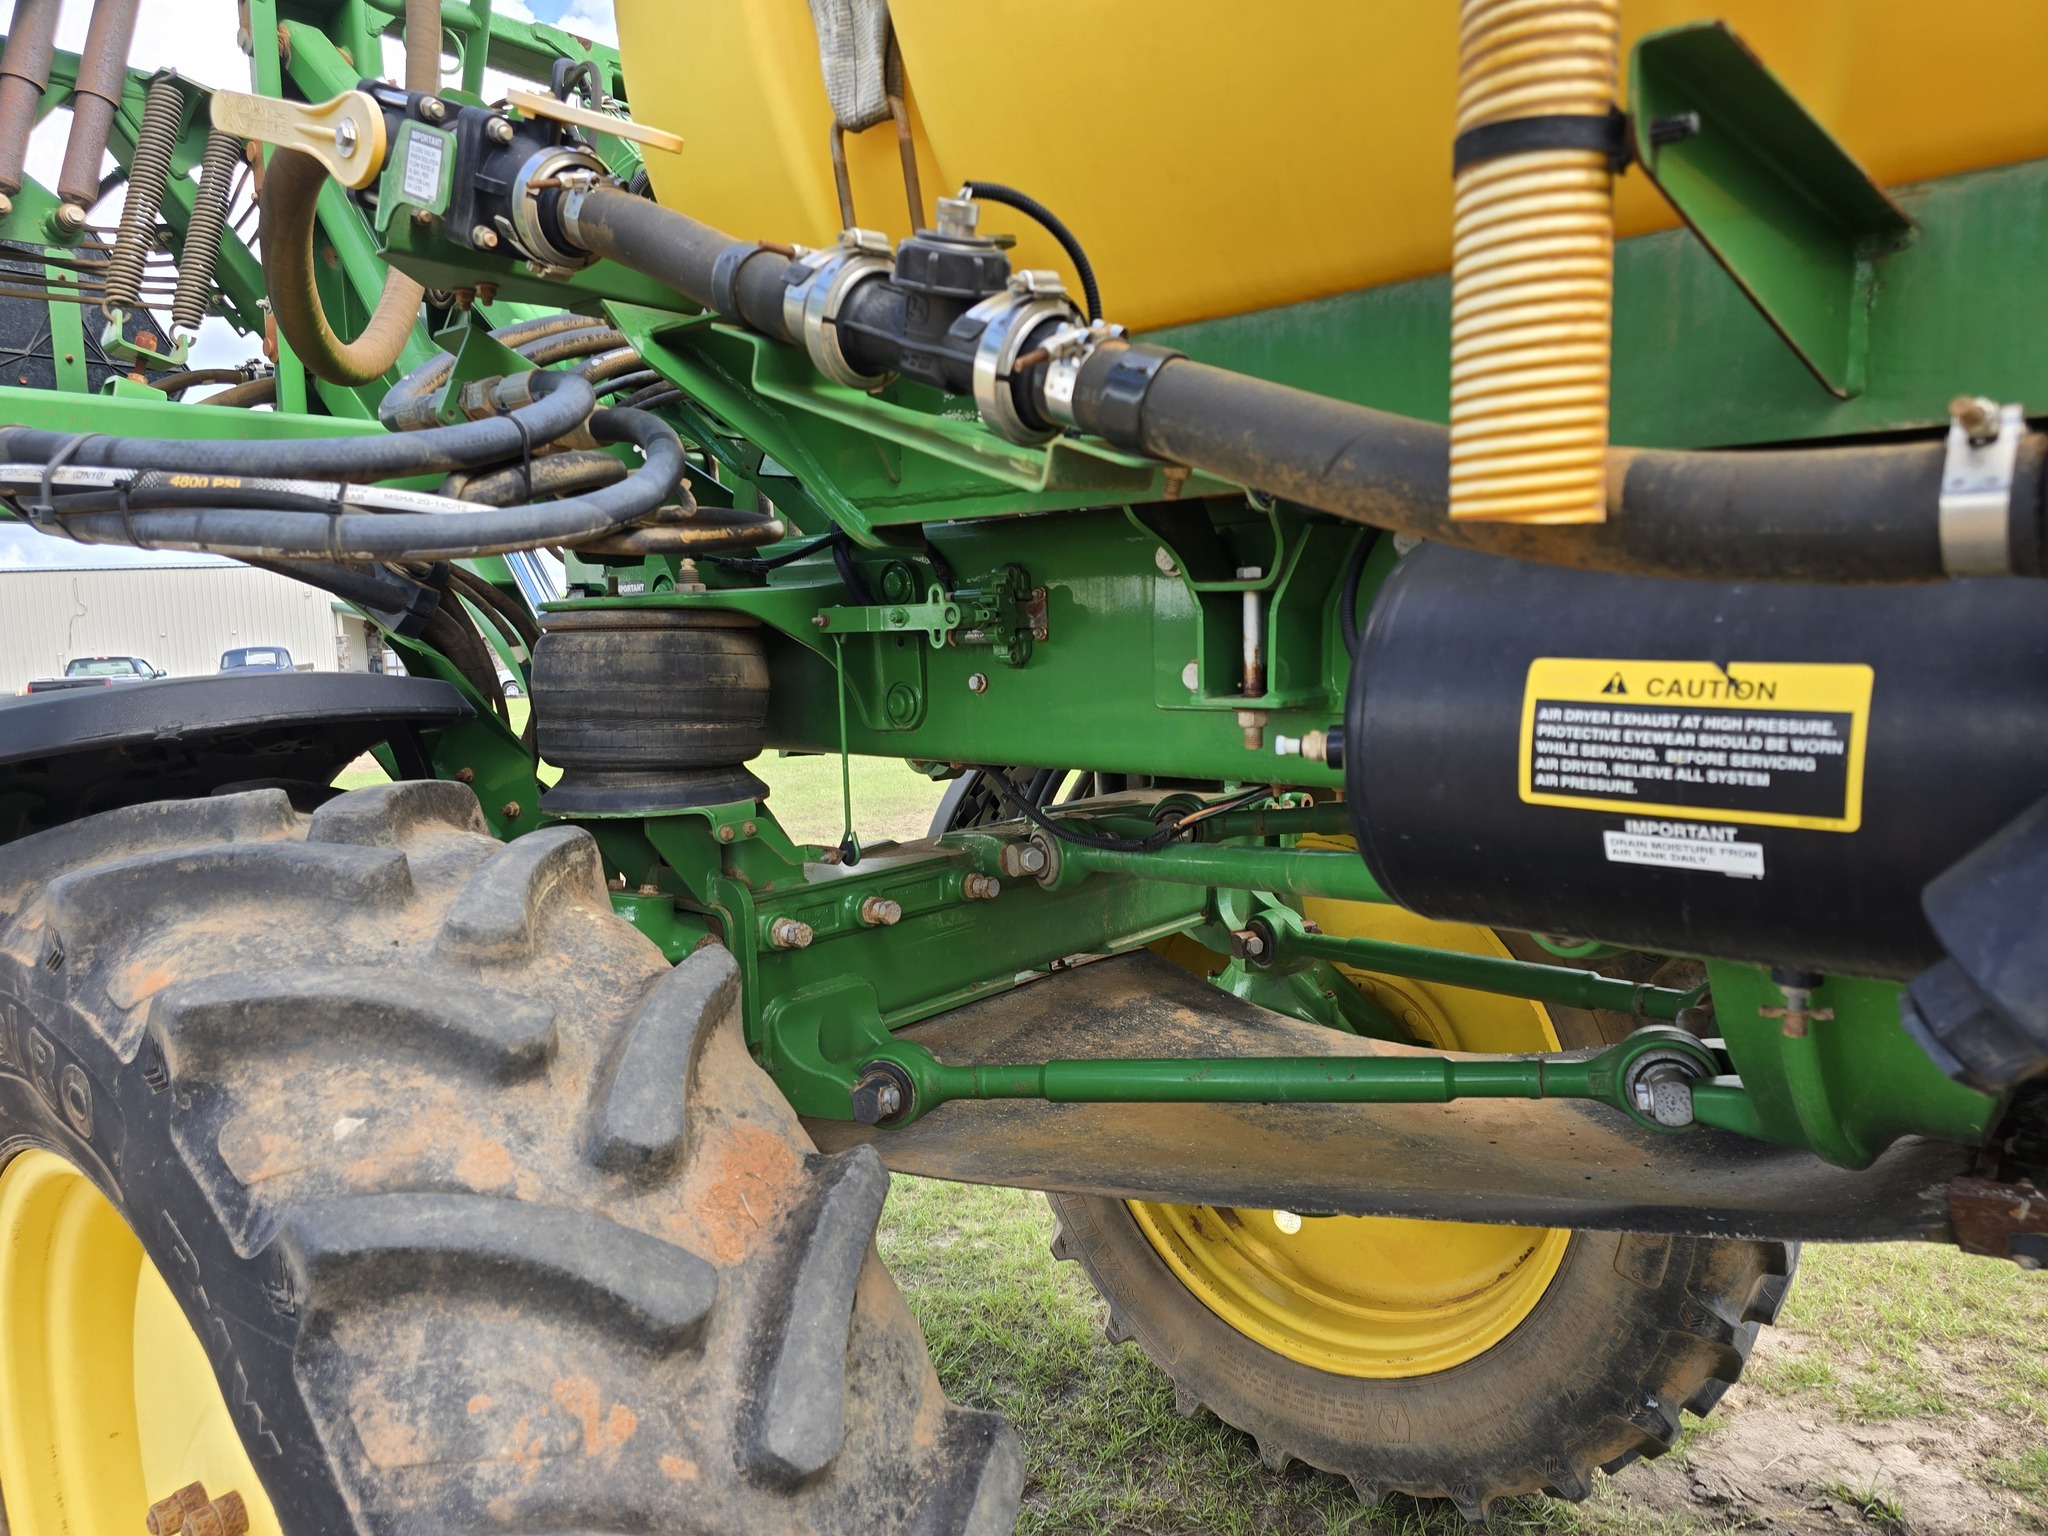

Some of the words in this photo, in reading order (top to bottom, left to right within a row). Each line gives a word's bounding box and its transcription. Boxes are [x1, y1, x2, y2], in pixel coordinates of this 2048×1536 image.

[411, 130, 443, 147] IMPORTANT
[169, 475, 209, 489] 4800
[212, 478, 242, 489] PSI
[618, 583, 645, 593] PORTANT
[1646, 678, 1777, 701] CAUTION
[1538, 707, 1562, 721] AIR
[1563, 708, 1610, 724] DRYER
[1612, 711, 1681, 729] EXHAUST
[1681, 714, 1702, 730] AT
[1703, 716, 1743, 731] HIGH
[1744, 717, 1838, 736] PRESSURE.
[1536, 723, 1622, 741] PROTECTIVE
[1622, 728, 1696, 747] EYEWEAR
[1698, 732, 1763, 750] SHOULD
[1764, 736, 1788, 752] BE
[1790, 738, 1845, 755] WORN
[1535, 740, 1578, 757] WHILE
[1580, 742, 1660, 763] SERVICING.
[1664, 748, 1727, 767] BEFORE
[1729, 752, 1817, 773] SERVICING
[1535, 757, 1558, 771] AIR
[1560, 759, 1611, 777] DRYER,
[1612, 762, 1673, 780] RELIEVE
[1674, 767, 1704, 783] ALL
[1705, 769, 1771, 787] SYSTEM
[1535, 773, 1558, 787] AIR
[1560, 775, 1638, 795] PRESSURE.
[1624, 819, 1738, 842] IMPORTANT
[1610, 838, 1648, 849] DRAIN
[1650, 842, 1717, 857] MOISTURE
[1720, 848, 1759, 860] FROM
[1612, 849, 1632, 857] AIR
[1635, 851, 1667, 862] TANK
